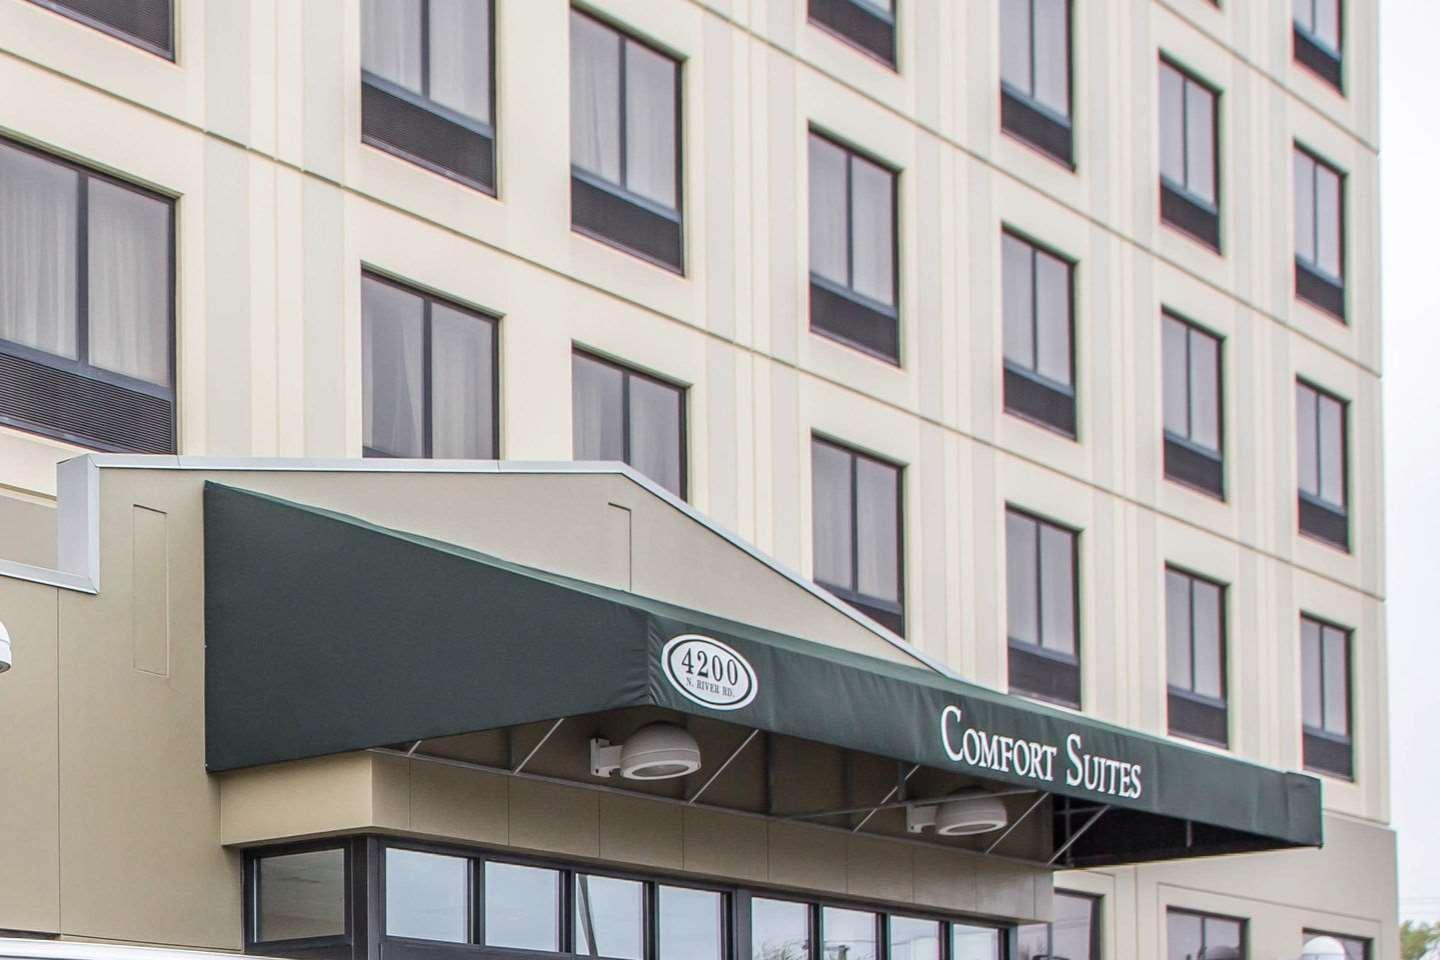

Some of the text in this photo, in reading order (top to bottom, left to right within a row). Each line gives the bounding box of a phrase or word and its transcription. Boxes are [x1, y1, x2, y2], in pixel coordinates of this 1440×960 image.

[681, 647, 738, 686] 4200
[686, 678, 736, 698] N. RIVER RD.
